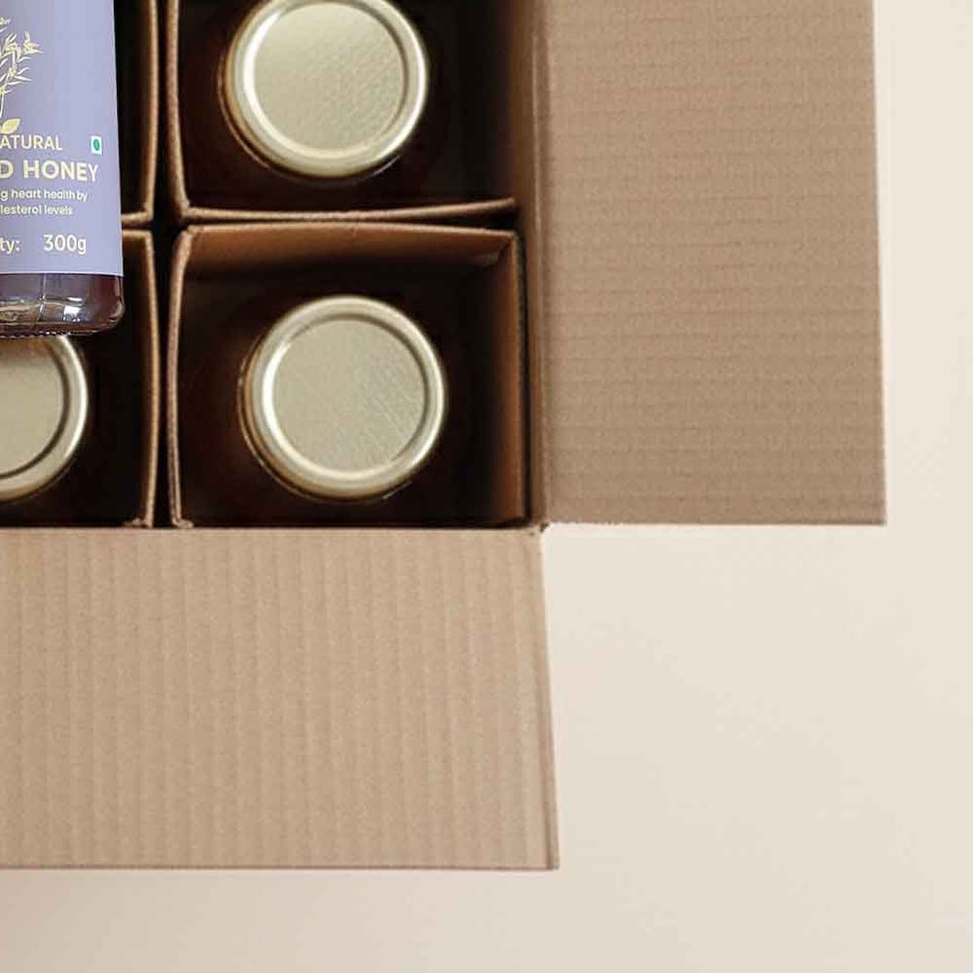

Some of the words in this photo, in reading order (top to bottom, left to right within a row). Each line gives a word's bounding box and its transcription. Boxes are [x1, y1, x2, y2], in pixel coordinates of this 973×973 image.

[23, 160, 98, 181] HONEY
[11, 188, 41, 200] heart
[43, 188, 75, 200] health
[75, 190, 87, 202] by
[44, 205, 73, 216] levels
[43, 235, 87, 254] 300g
